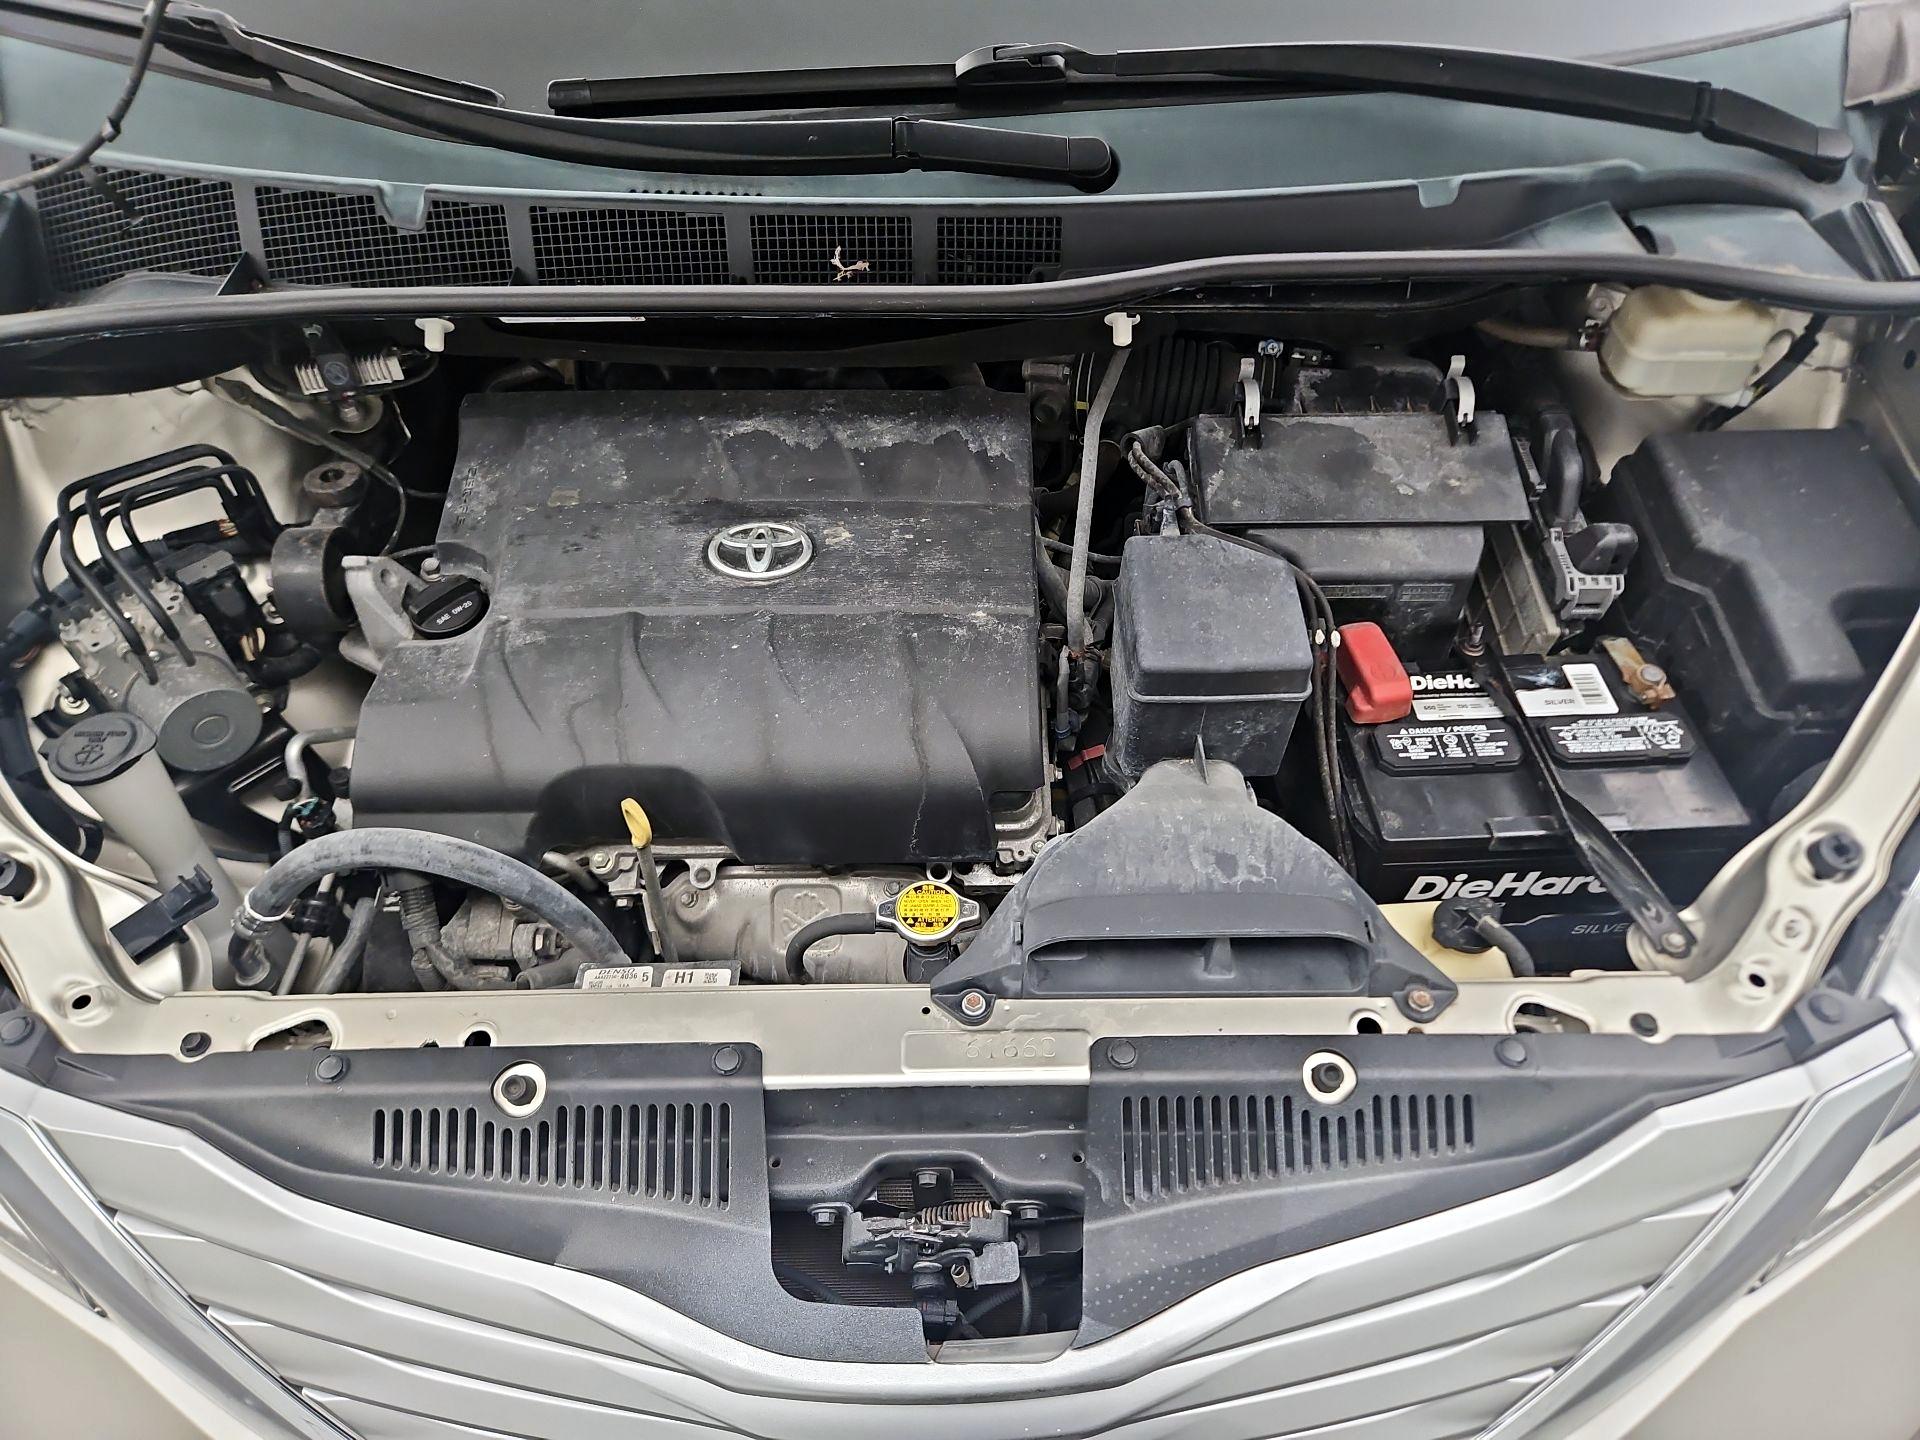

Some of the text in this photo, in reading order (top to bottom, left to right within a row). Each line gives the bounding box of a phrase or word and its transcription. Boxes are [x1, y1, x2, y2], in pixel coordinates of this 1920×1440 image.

[436, 600, 473, 625] SAE 0W-20
[1409, 674, 1480, 691] DieHa
[1544, 698, 1576, 706] SILVER
[1408, 726, 1446, 735] DANGER
[1453, 724, 1488, 733] POISON
[1571, 922, 1629, 935] SILVE
[598, 967, 636, 976] DENSO
[641, 971, 650, 983] 5
[674, 971, 695, 984] H1
